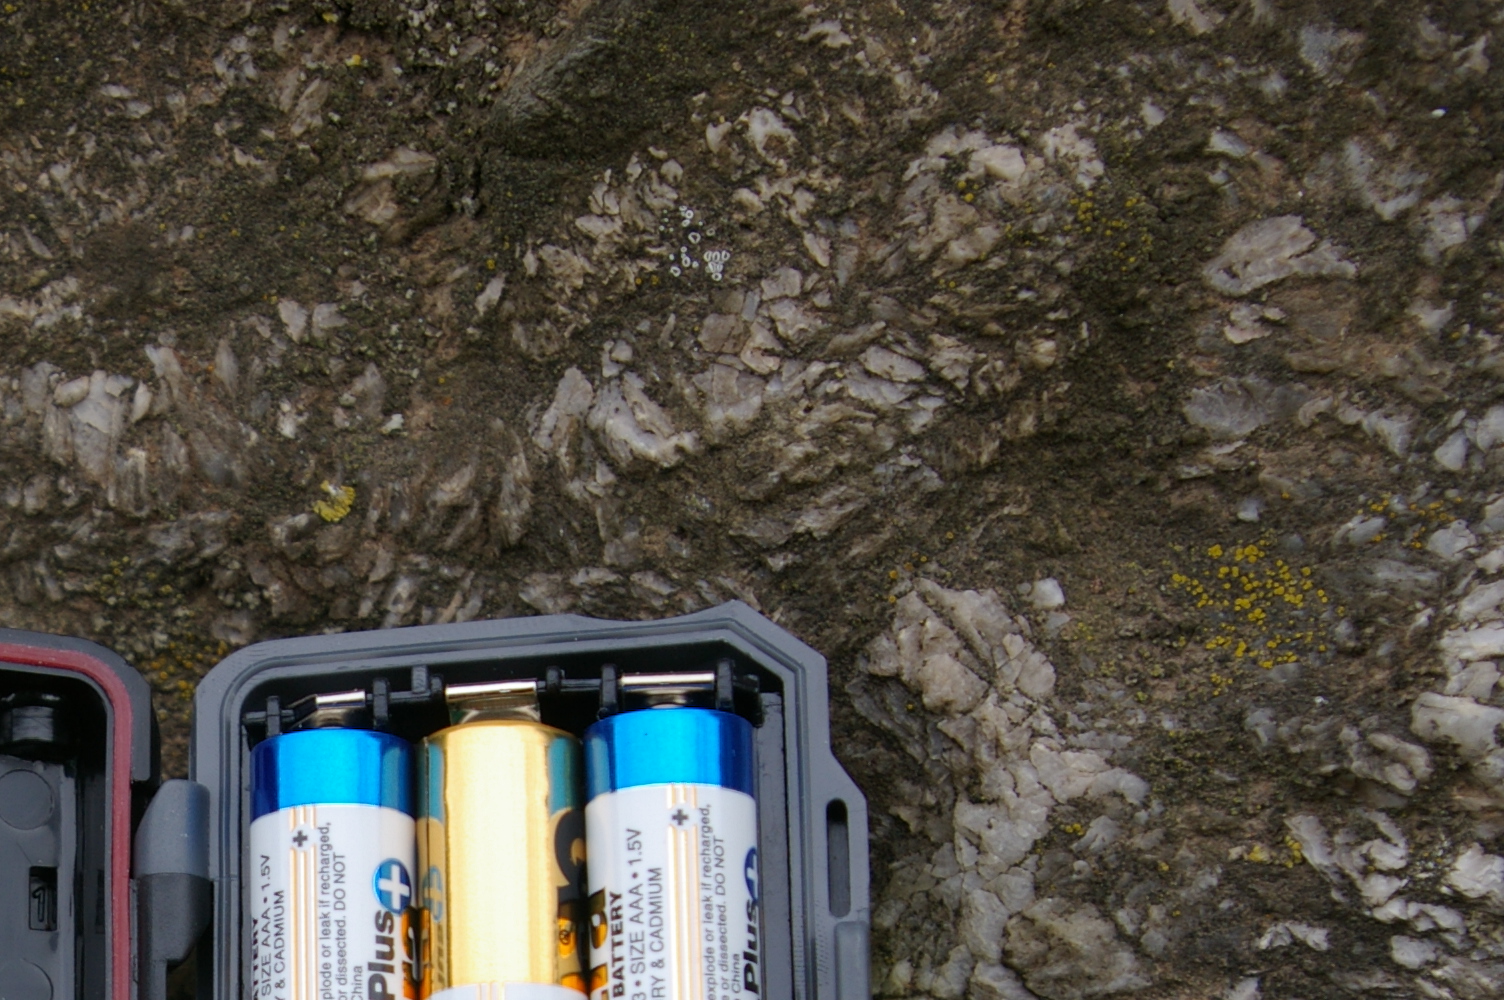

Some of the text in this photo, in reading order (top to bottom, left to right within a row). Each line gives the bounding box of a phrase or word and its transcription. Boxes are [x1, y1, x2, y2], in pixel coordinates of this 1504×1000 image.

[318, 822, 332, 895] recharged,
[625, 828, 642, 866] 1.5V
[699, 804, 714, 879] recharged,
[712, 836, 725, 869] NOT
[260, 854, 271, 891] 1.5V
[333, 852, 346, 884] NOT
[714, 873, 726, 896] DO
[334, 888, 346, 911] DO
[628, 883, 644, 925] AAA
[647, 867, 665, 953] CADMIUM
[701, 895, 714, 926] leak
[261, 907, 271, 947] AAA
[273, 890, 285, 973] CADMIUM
[319, 912, 331, 940] leak
[609, 891, 625, 998] BATTERY
[704, 929, 714, 942] or
[716, 901, 728, 973] dissected.
[320, 944, 331, 958] or
[335, 916, 348, 985] dissected.
[629, 930, 646, 974] SIZE
[650, 957, 665, 969] &
[261, 953, 272, 996] SIZE
[274, 978, 286, 989] &
[720, 977, 730, 990] or
[730, 953, 742, 994] China
[337, 986, 347, 999] or
